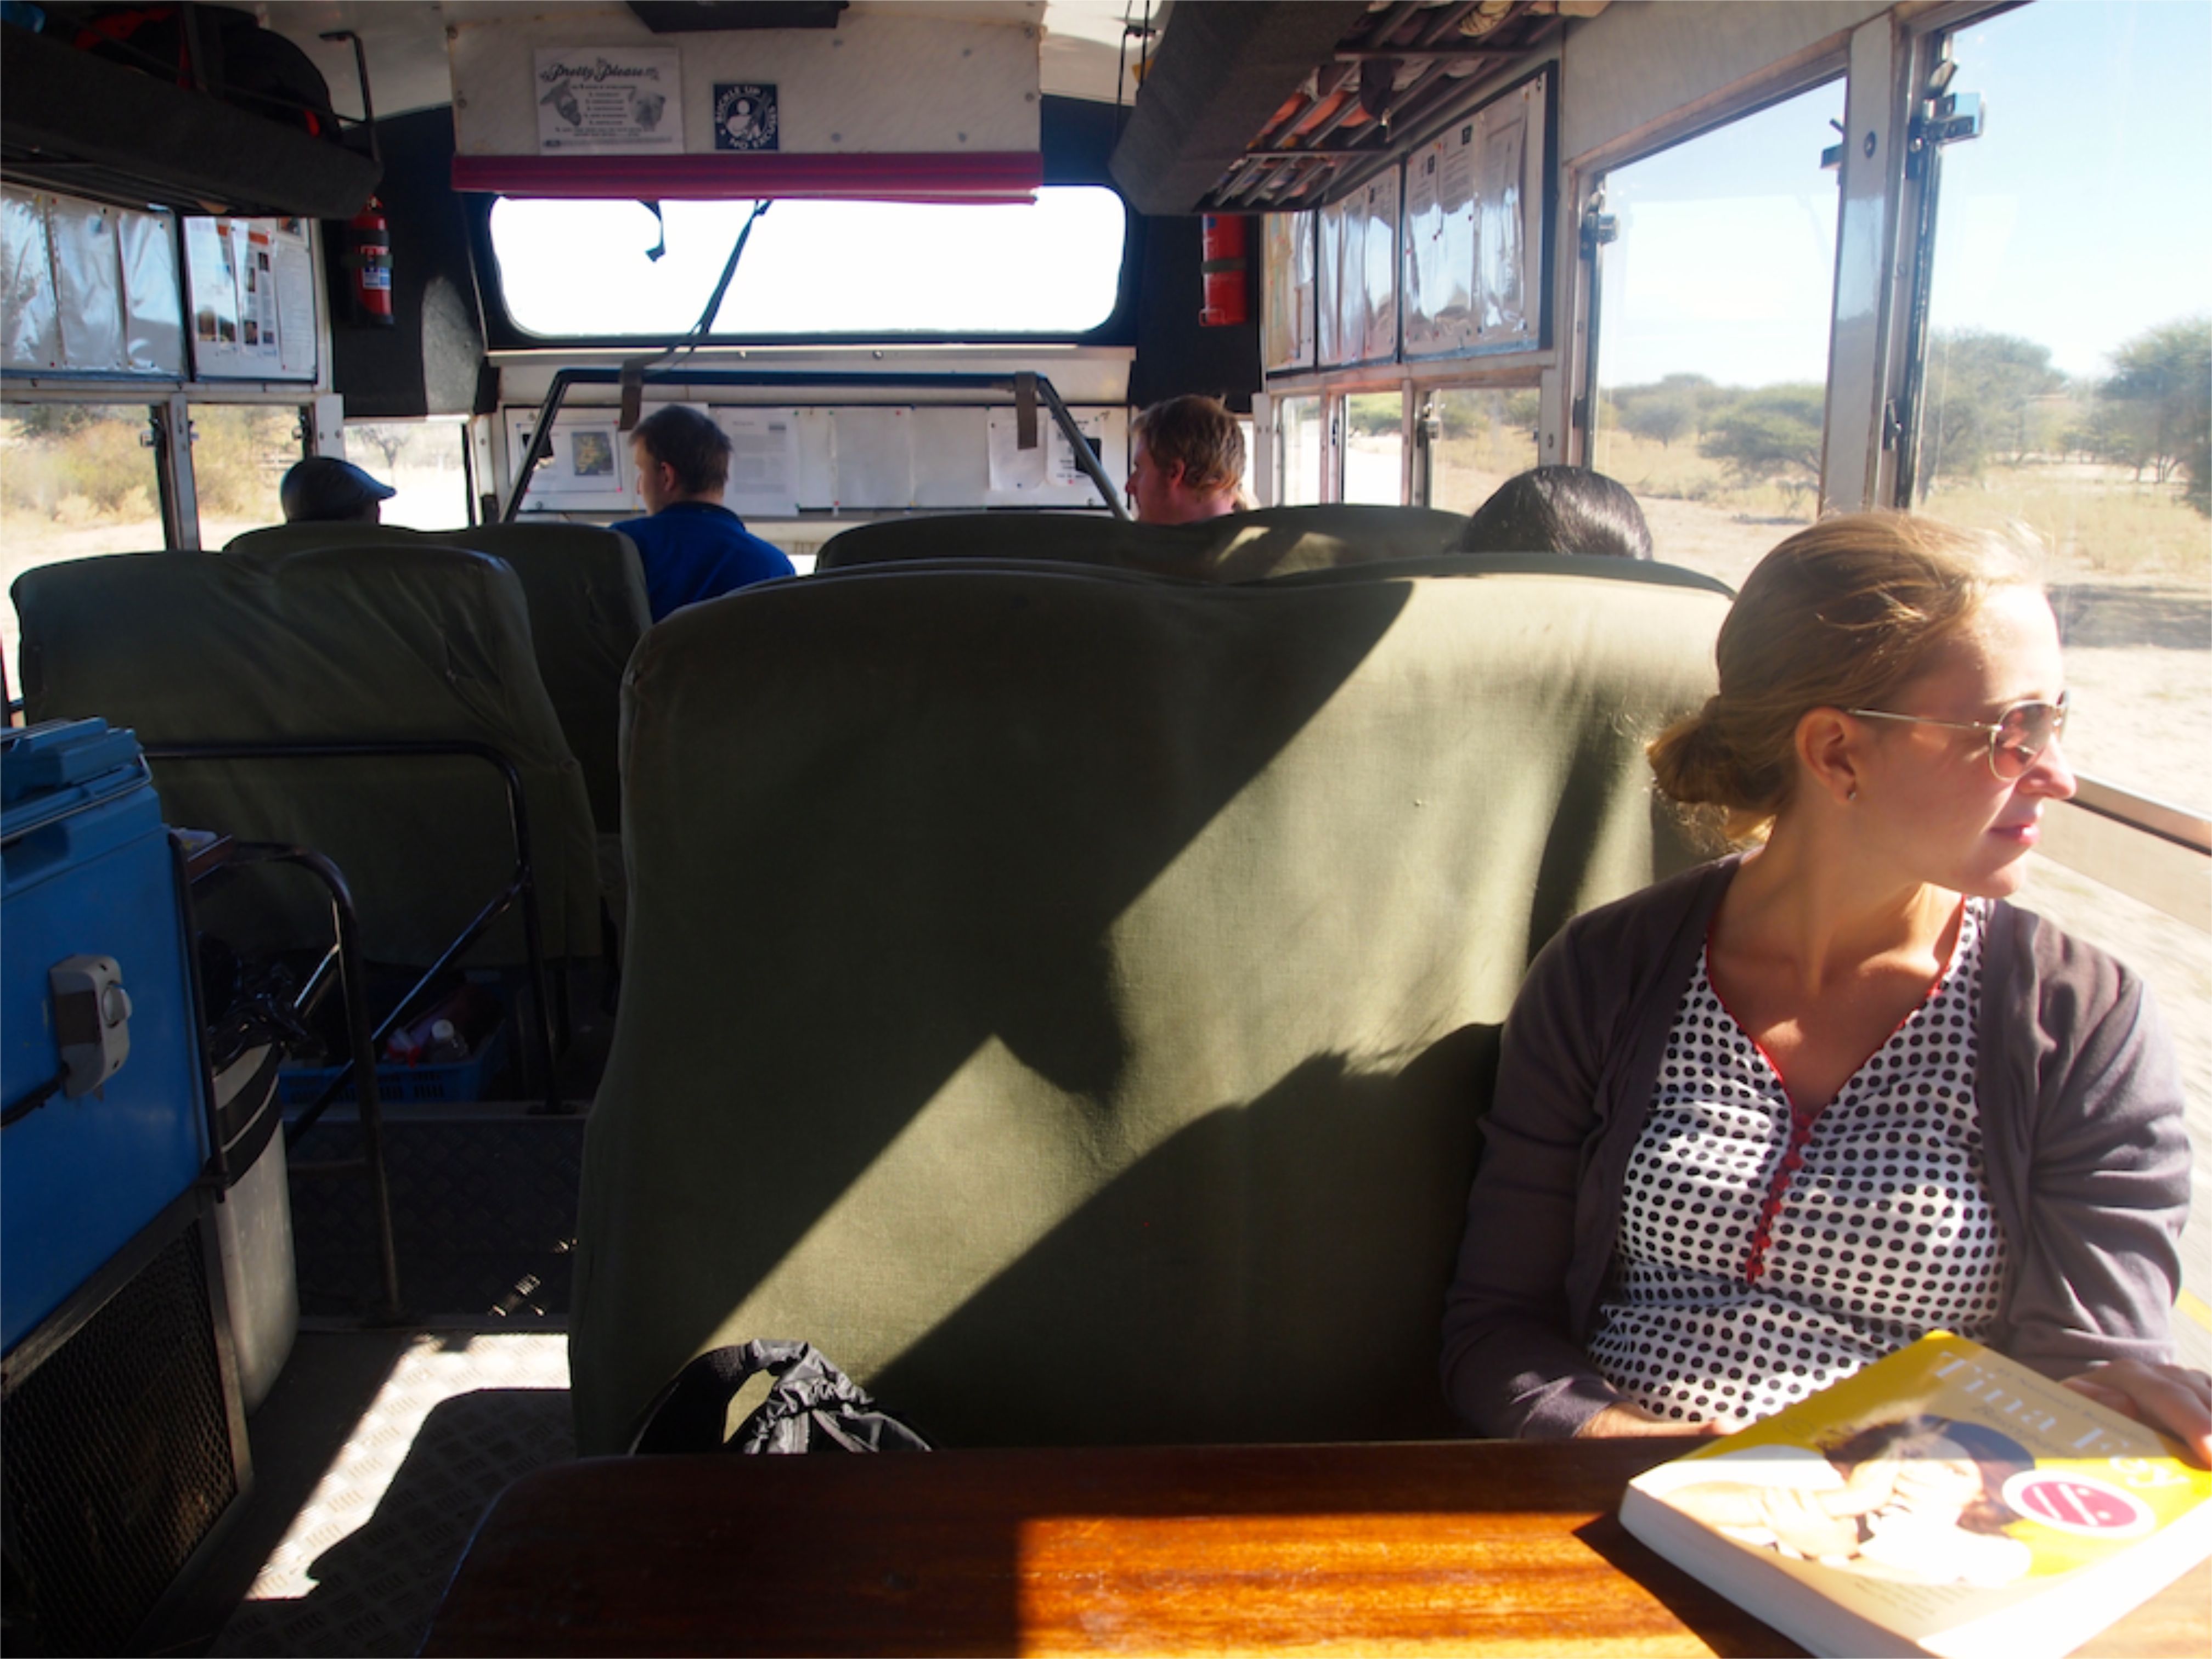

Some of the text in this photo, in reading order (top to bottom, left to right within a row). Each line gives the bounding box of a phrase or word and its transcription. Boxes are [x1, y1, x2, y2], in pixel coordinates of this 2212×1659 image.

[549, 61, 644, 82] Pretty Please
[744, 86, 761, 95] UP
[1935, 1350, 2057, 1432] Tina
[2072, 1427, 2192, 1488] Fey
